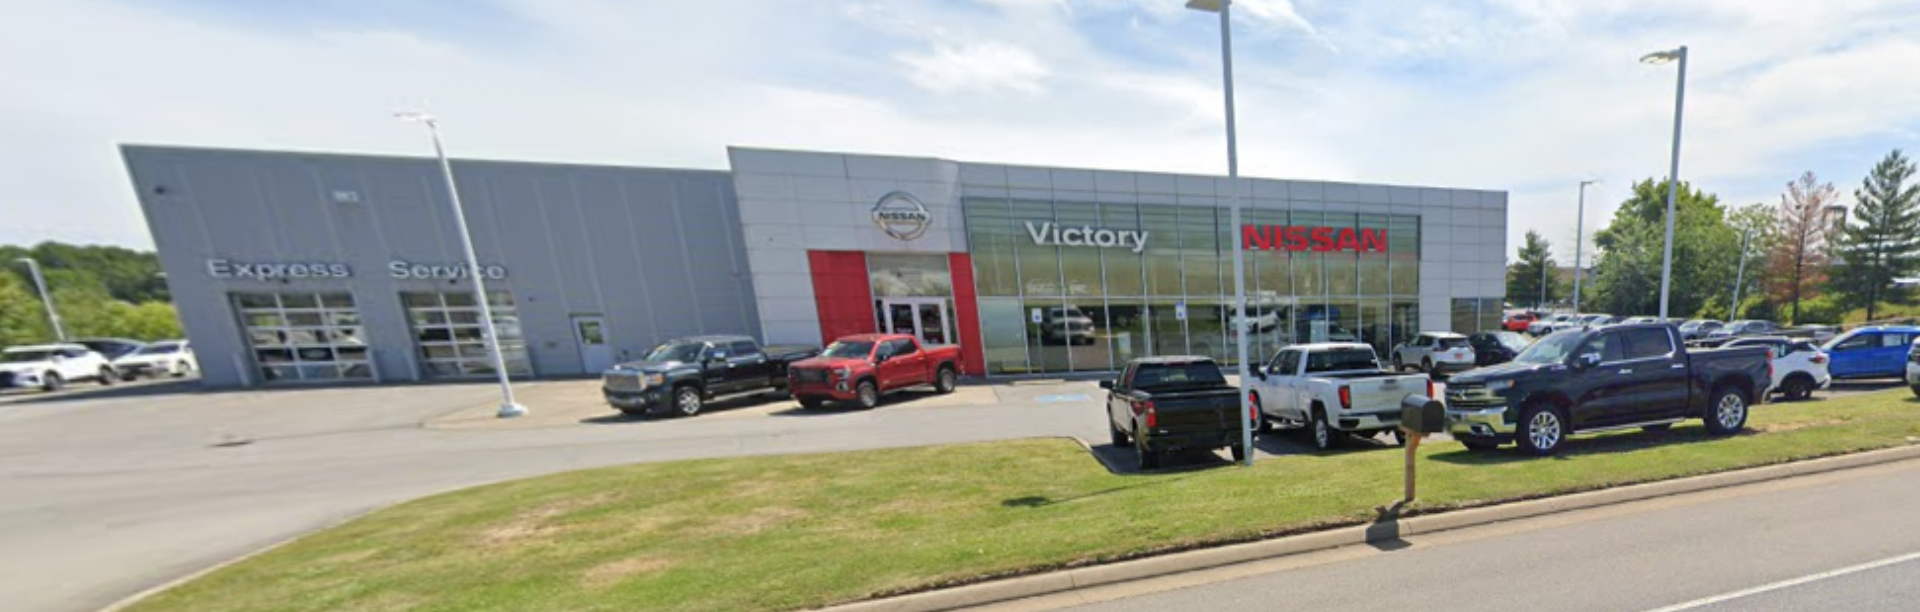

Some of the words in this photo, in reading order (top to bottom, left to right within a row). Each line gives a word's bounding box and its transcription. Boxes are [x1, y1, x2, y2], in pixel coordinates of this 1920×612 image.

[878, 212, 926, 221] NISSAN
[1024, 221, 1149, 253] Victory
[1241, 223, 1387, 253] NISSAN
[207, 259, 350, 281] Express
